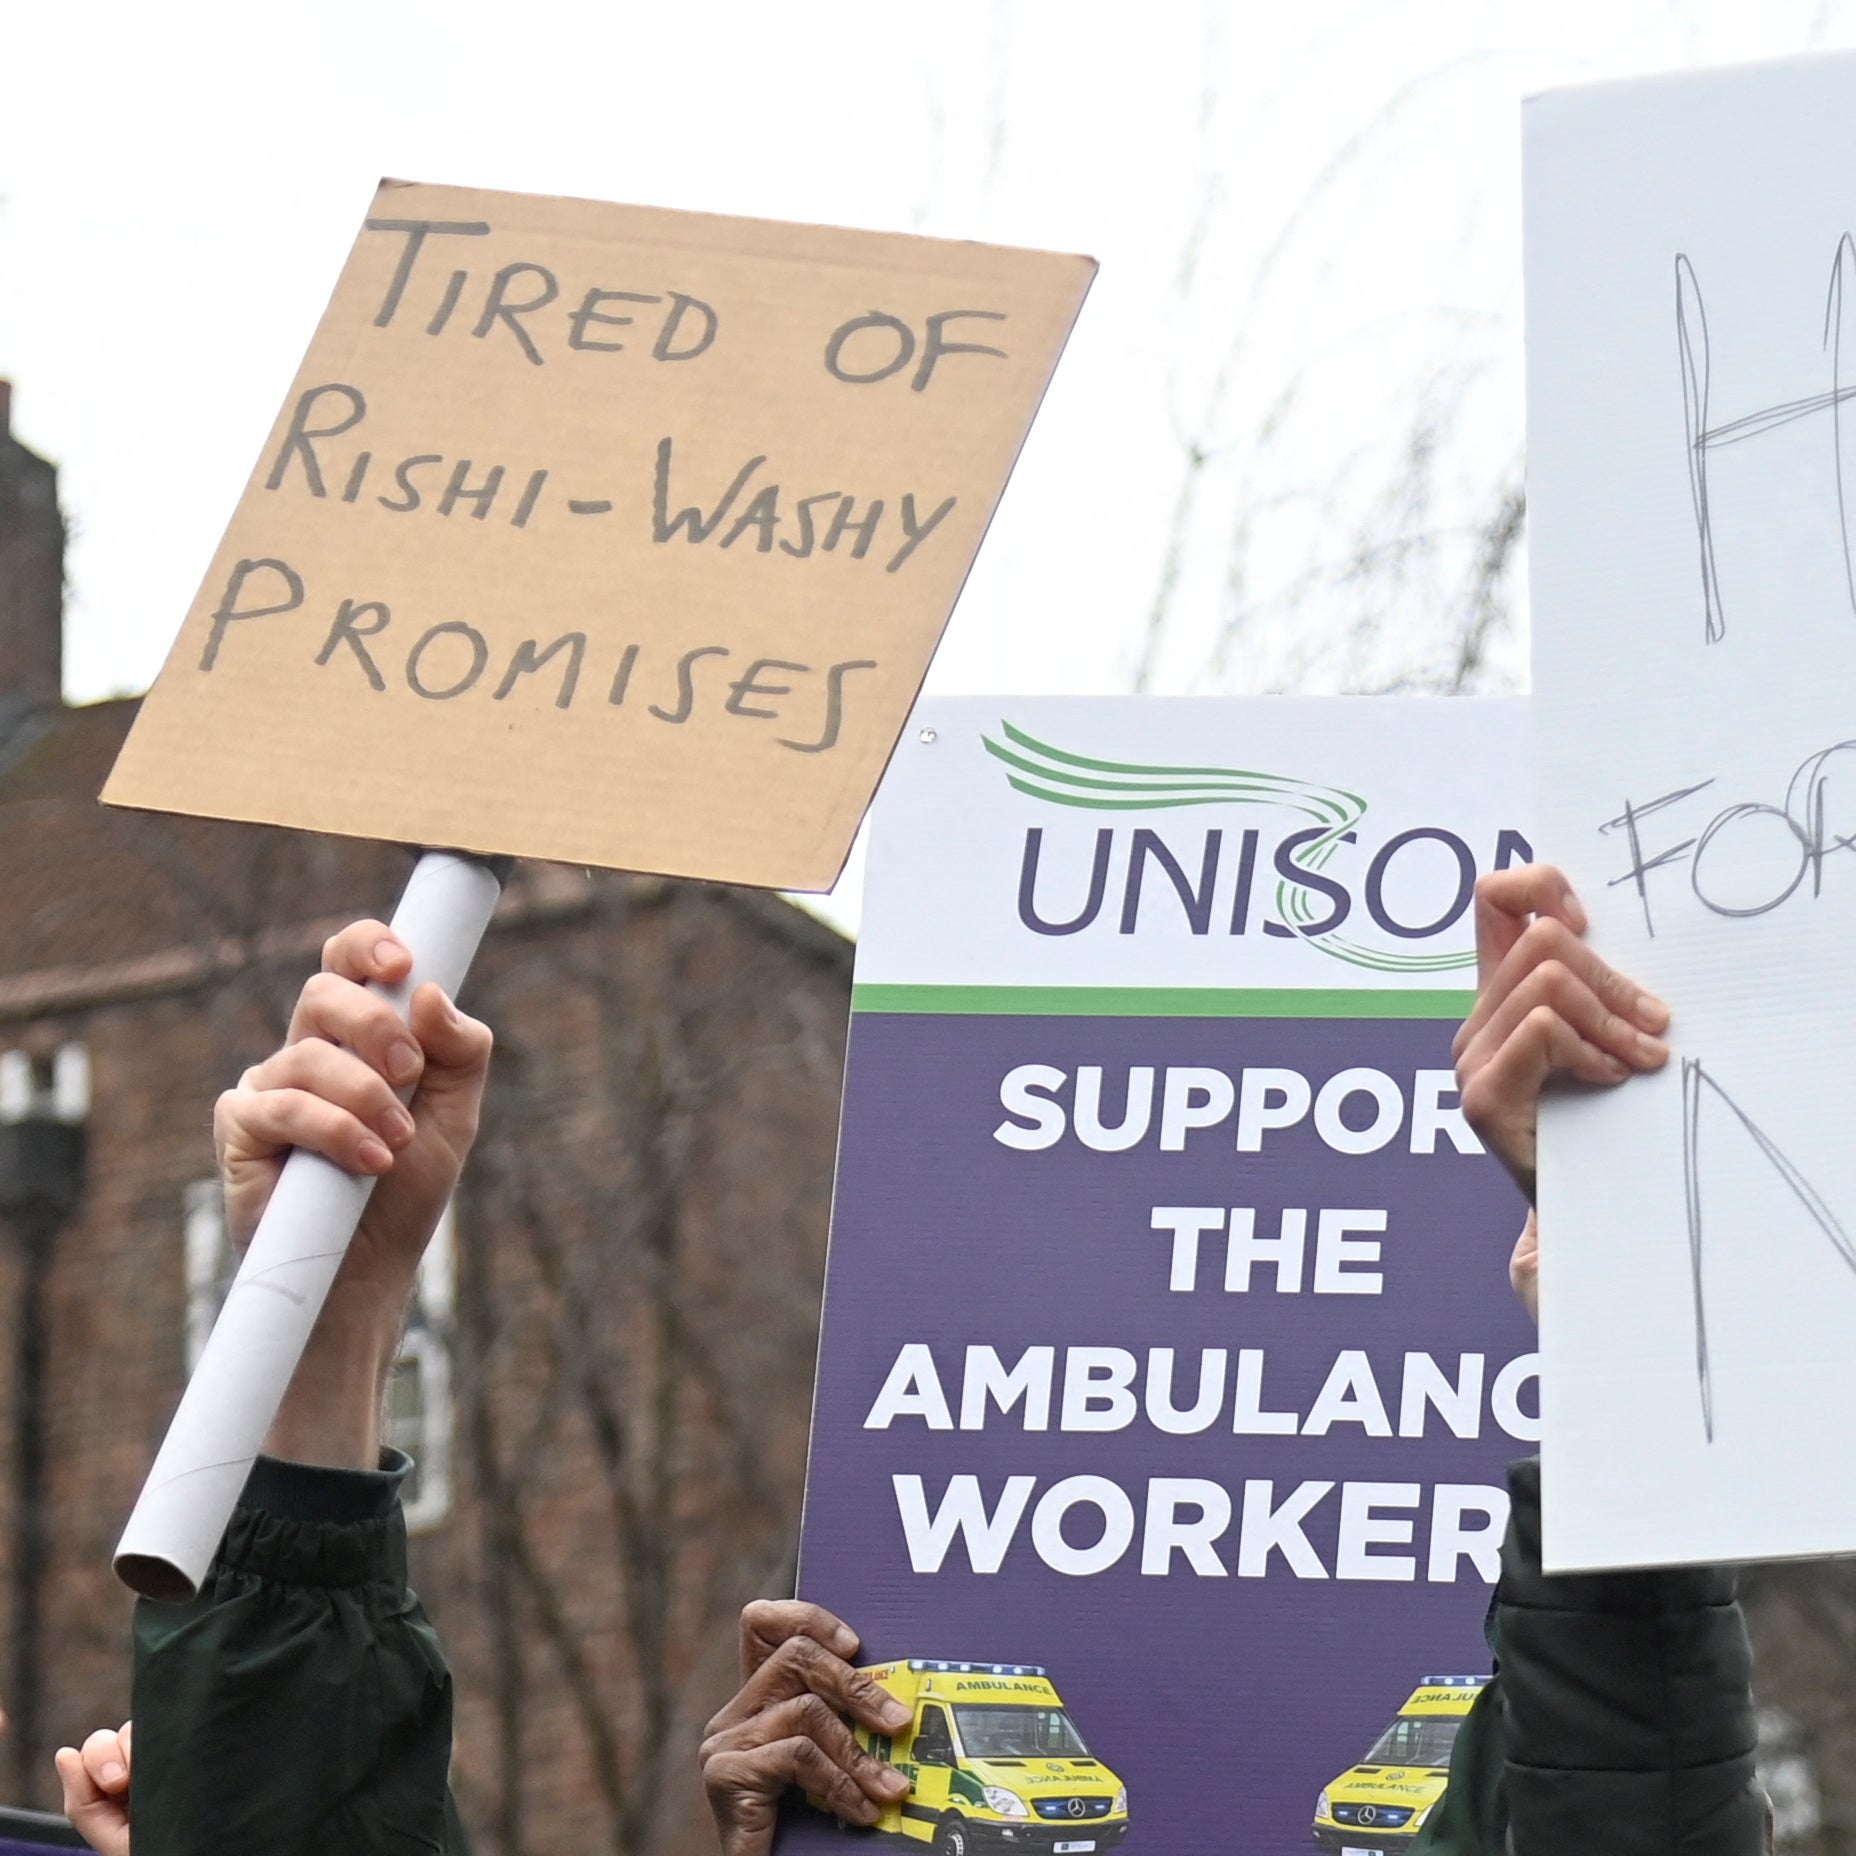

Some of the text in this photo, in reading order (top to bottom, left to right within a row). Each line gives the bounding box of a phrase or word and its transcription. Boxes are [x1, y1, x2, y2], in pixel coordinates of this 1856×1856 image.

[365, 218, 1010, 392] TIRED OF
[196, 557, 879, 754] PROMISES
[992, 1064, 1487, 1154] SUPPOR
[1151, 1207, 1388, 1295] THE
[863, 1343, 1542, 1442] AMBULANC
[892, 1473, 1511, 1584] WORKER
[955, 1679, 1053, 1696] AMBULANCE
